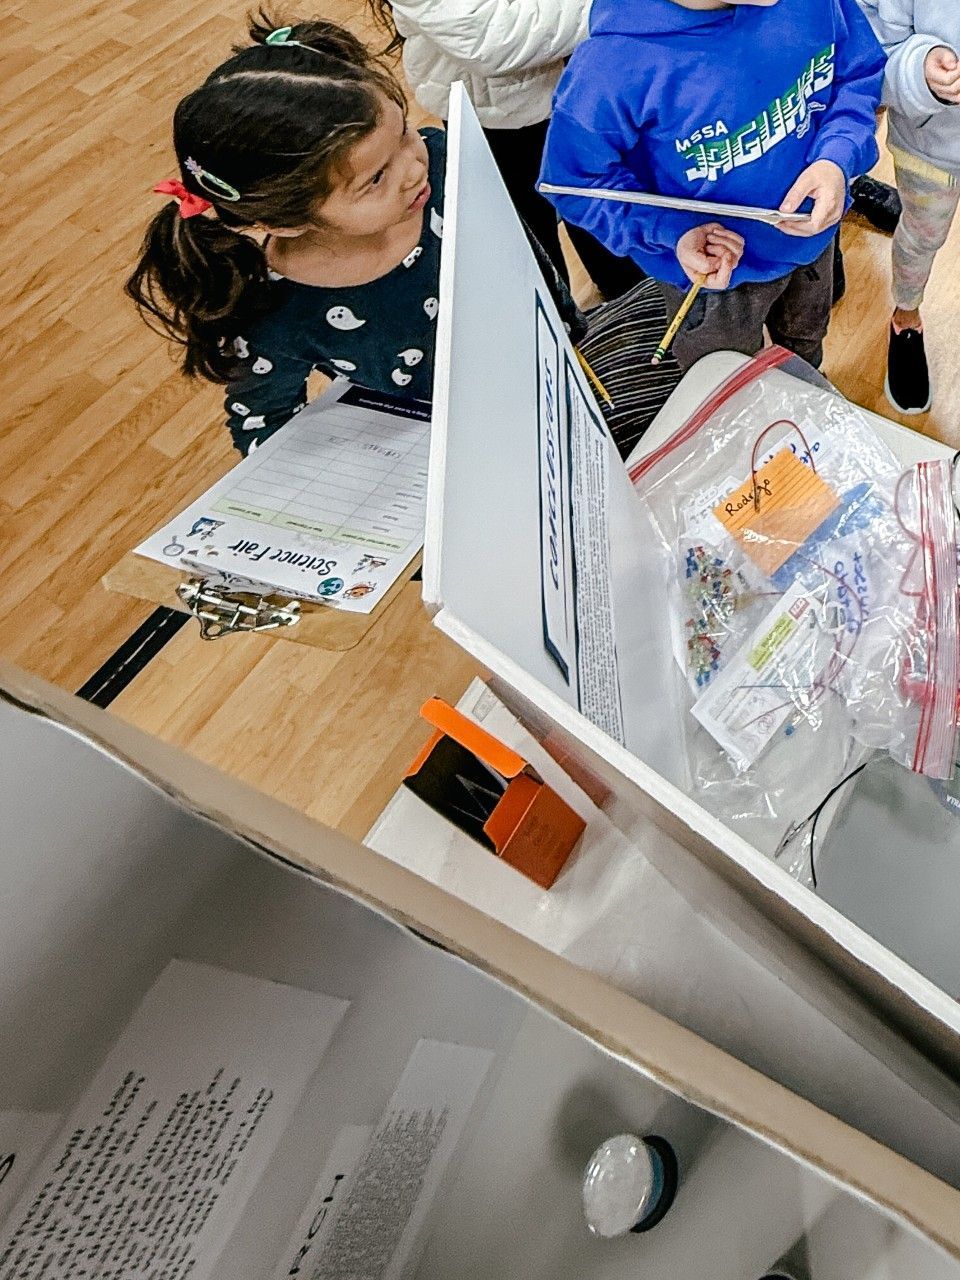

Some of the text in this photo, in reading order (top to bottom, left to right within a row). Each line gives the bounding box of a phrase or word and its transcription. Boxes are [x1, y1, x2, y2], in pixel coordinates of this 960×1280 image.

[675, 120, 729, 153] MSSA
[227, 538, 338, 577] Science Fair
